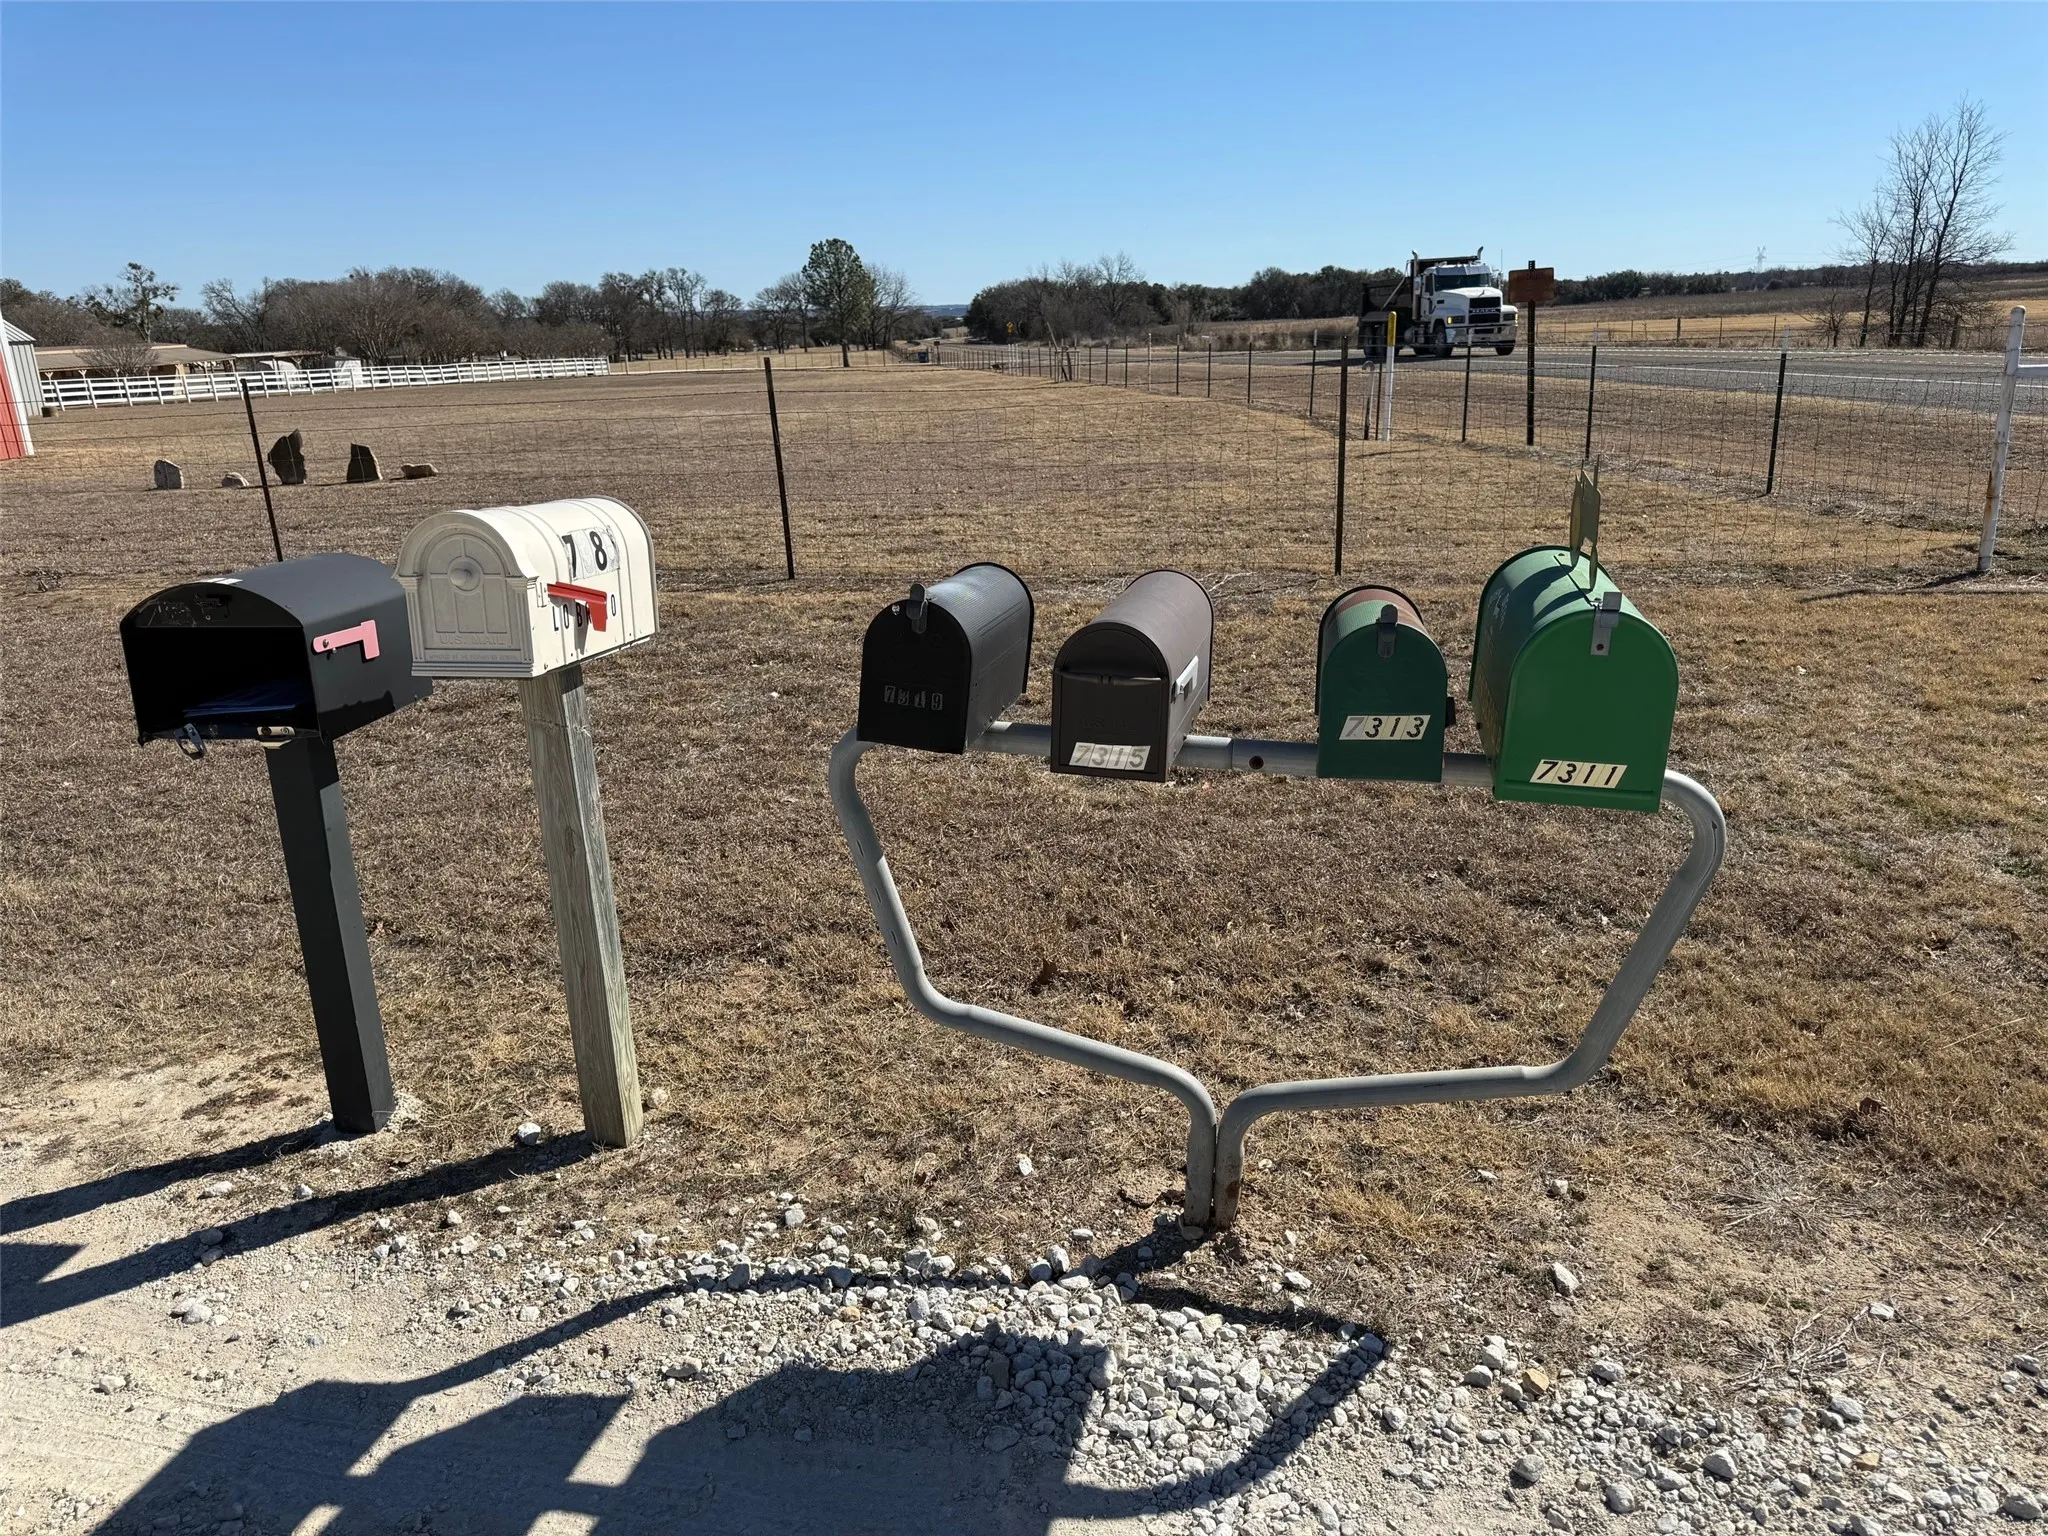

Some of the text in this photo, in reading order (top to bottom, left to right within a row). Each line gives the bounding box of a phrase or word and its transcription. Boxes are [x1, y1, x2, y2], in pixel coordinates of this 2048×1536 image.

[472, 634, 505, 646] MAIL
[1346, 716, 1425, 738] 7313
[1075, 745, 1146, 768] 7315
[1536, 761, 1619, 786] 7311
